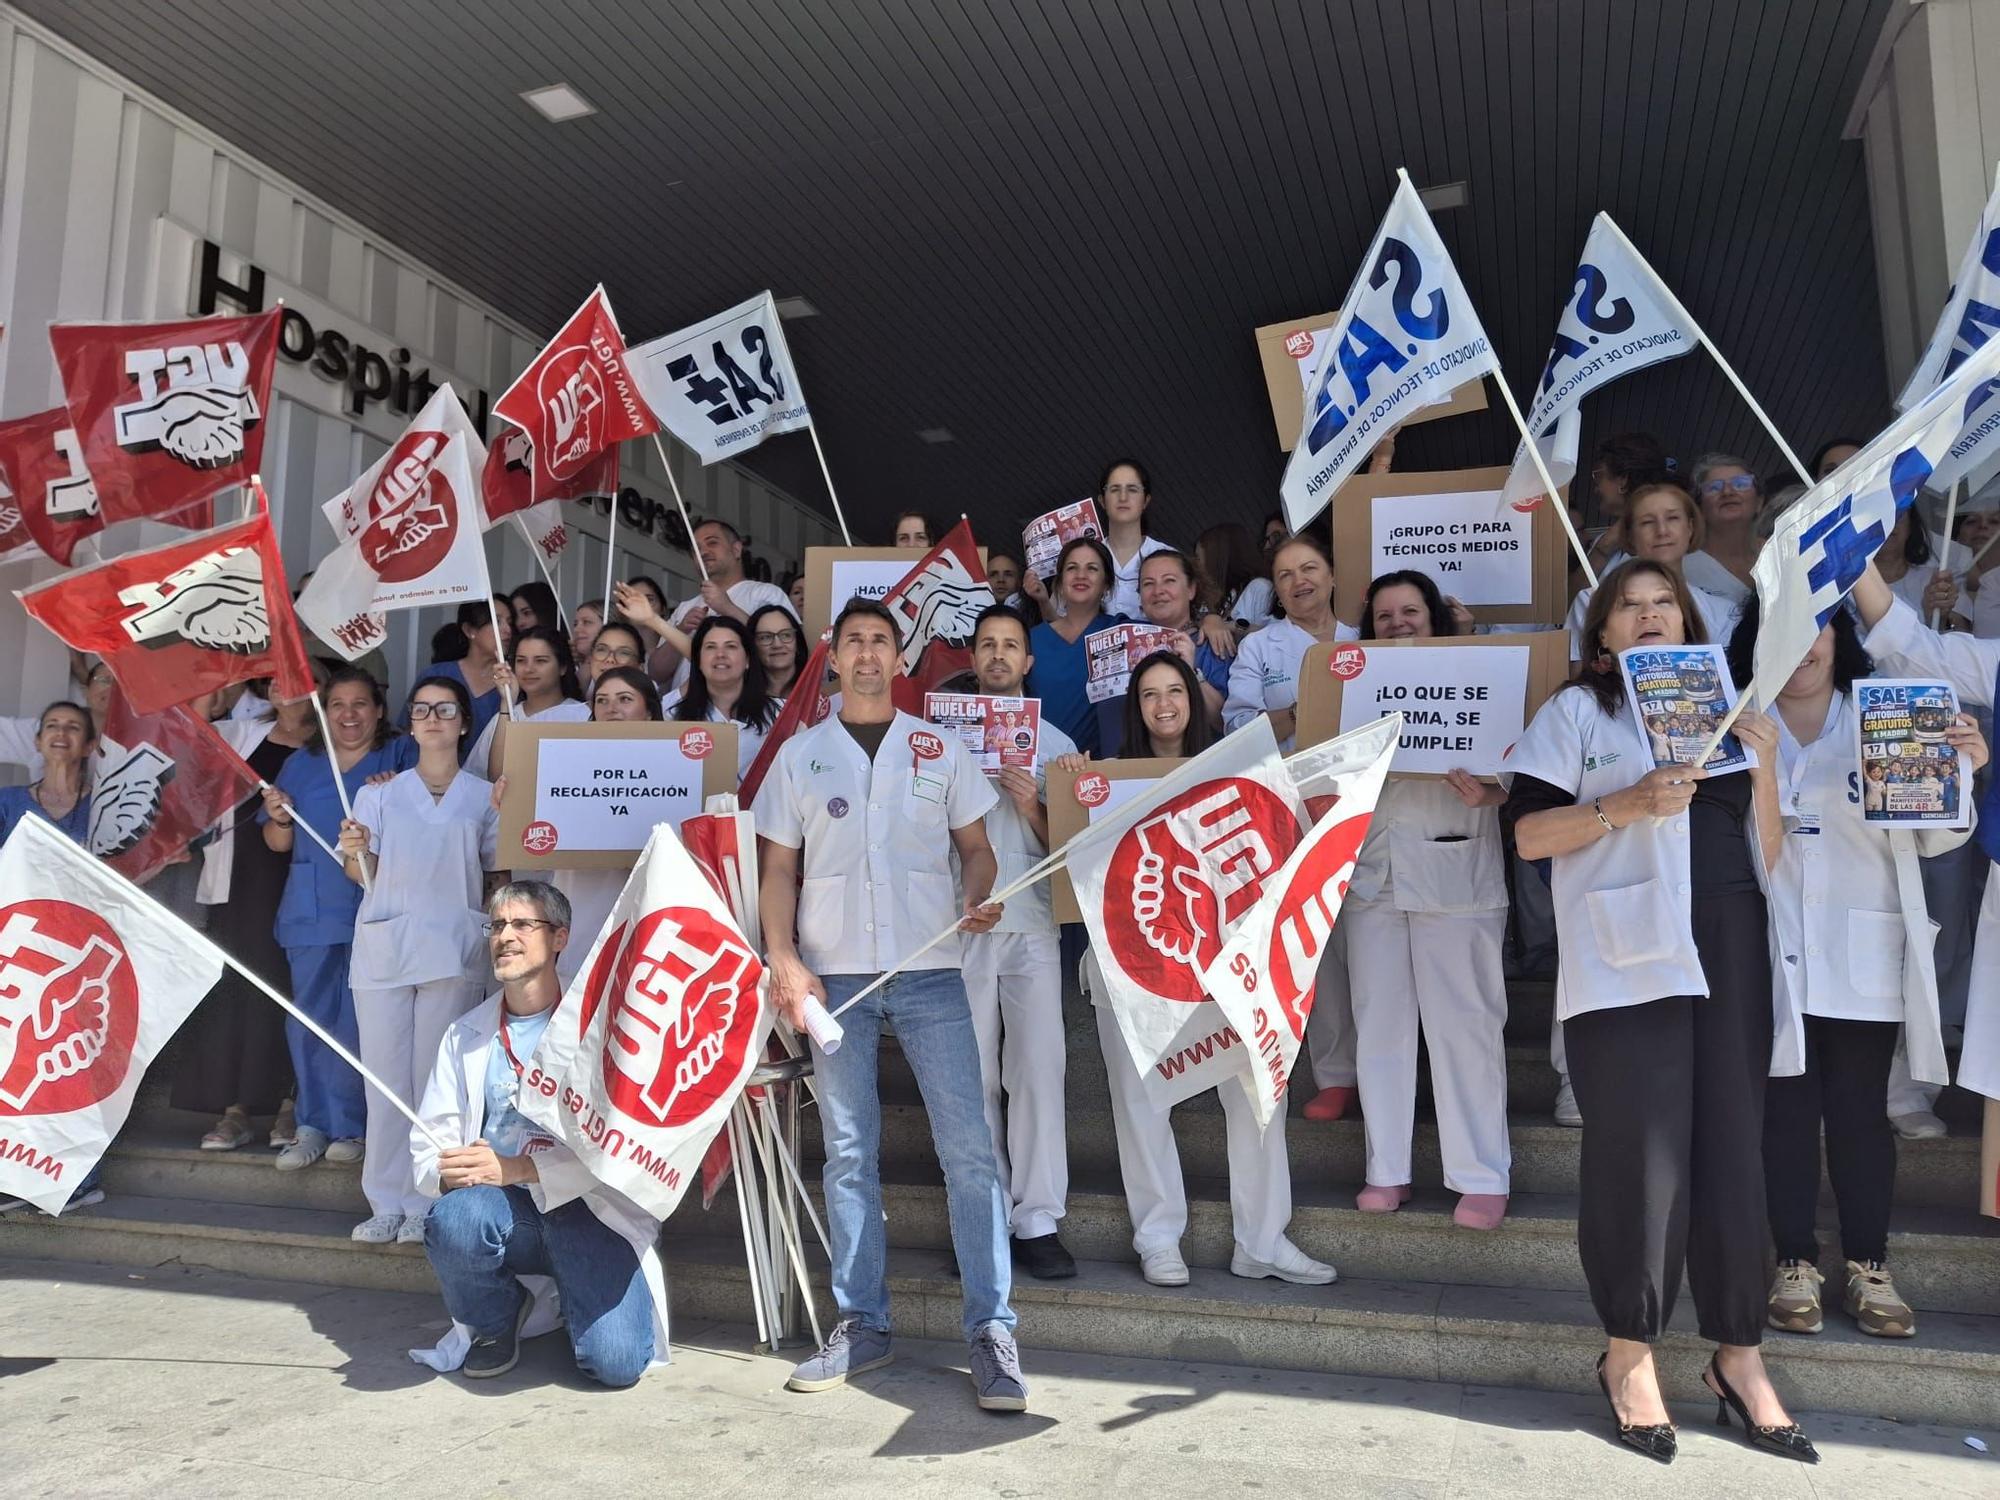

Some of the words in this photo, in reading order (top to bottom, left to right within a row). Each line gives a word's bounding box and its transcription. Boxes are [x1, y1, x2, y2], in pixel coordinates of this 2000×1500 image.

[1389, 525, 1445, 540] ¡GRUPO
[1450, 524, 1467, 535] C1
[1473, 522, 1512, 534] PARA
[1383, 543, 1457, 556] TÉCNICOS
[1462, 540, 1519, 553] MEDIOS
[1439, 561, 1462, 572] YA!
[1089, 630, 1129, 655] HUELGA
[1634, 652, 1672, 669] SAE
[1636, 671, 1677, 683] AUTOBUSES
[1637, 678, 1682, 691] GRATUITOS
[1376, 686, 1407, 702] ¡LO
[1414, 686, 1456, 701] QUE
[1463, 686, 1488, 700] SE
[1868, 687, 1907, 705] SAE
[930, 701, 987, 717] HUELGA
[1865, 709, 1910, 720] AUTOBUSES
[1456, 711, 1480, 726] SE
[1864, 718, 1912, 731] GRATUITOS
[913, 734, 939, 749] UGT
[1872, 731, 1879, 739] A
[1880, 730, 1908, 738] MADRID
[1399, 735, 1473, 751] UMPLE!
[1867, 745, 1881, 753] 17
[593, 769, 624, 780] POR
[629, 769, 648, 780] LA
[550, 785, 689, 798] RECLASIFICACIÓN
[609, 805, 629, 816] YA
[607, 918, 715, 1086] UGT
[562, 1086, 682, 1192] www.UGT.es
